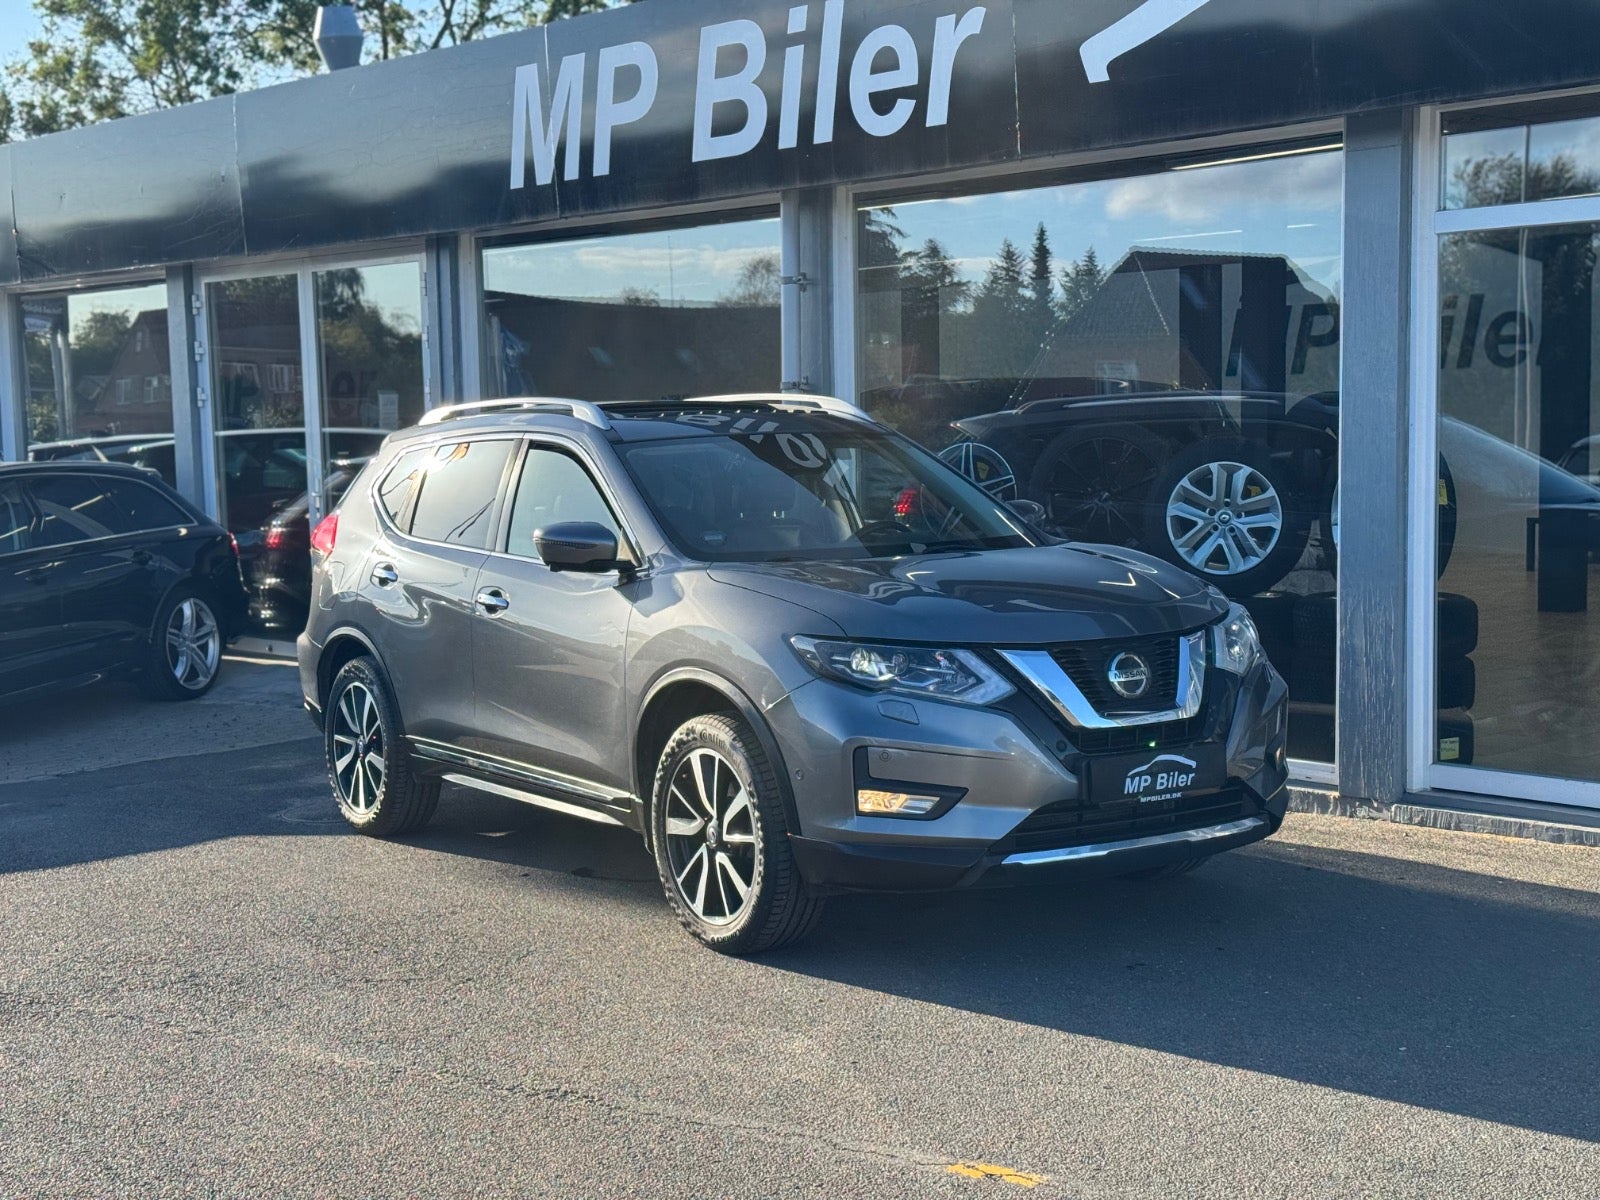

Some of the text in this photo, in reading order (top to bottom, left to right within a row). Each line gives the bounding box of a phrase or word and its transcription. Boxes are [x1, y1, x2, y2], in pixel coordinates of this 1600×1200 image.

[509, 0, 986, 190] MP Biler
[1114, 669, 1146, 679] NISSAN
[1124, 771, 1195, 794] MP Biler
[1140, 792, 1182, 803] MPBILER.DK
